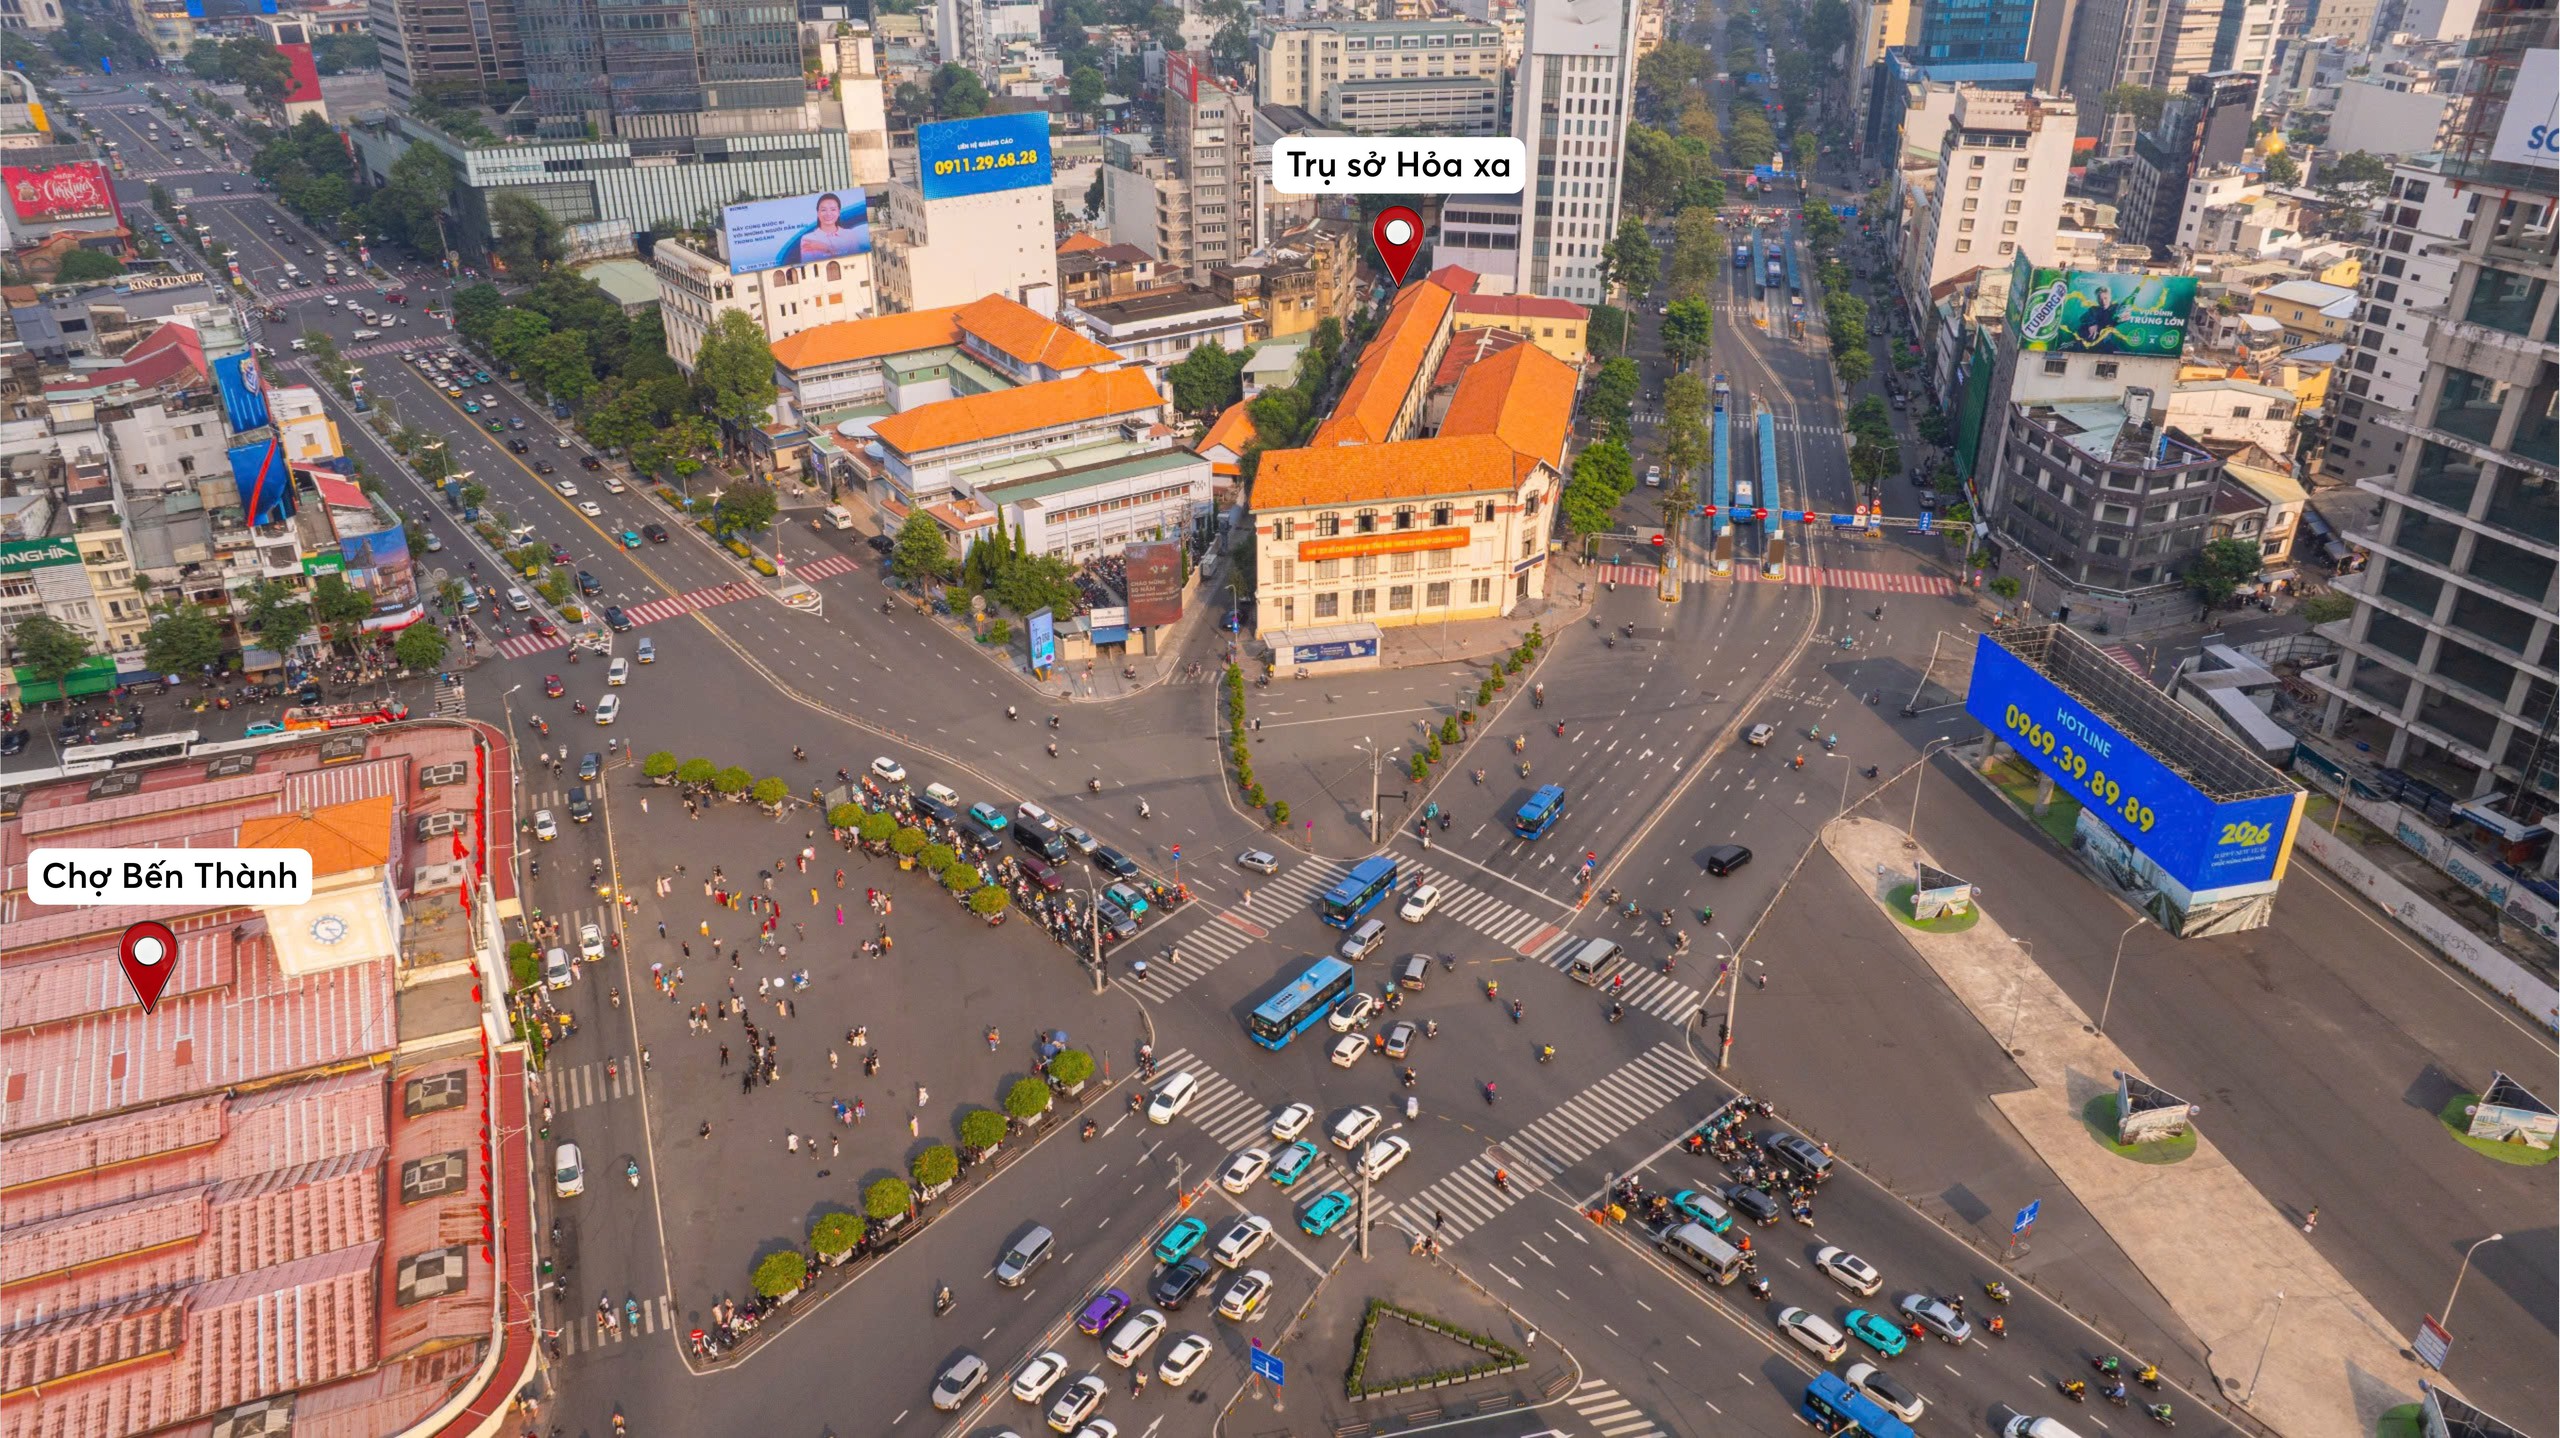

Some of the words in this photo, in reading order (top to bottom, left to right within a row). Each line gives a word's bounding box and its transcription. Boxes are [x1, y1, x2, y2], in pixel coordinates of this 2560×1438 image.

[957, 142, 969, 150] LIÊN
[978, 139, 999, 148] QUẢNG
[1000, 137, 1014, 145] CÁO
[934, 149, 1038, 176] 0911.29.68.28
[129, 279, 158, 291] KING
[160, 272, 204, 287] LUXURY
[2025, 293, 2061, 334] TUBORG
[2057, 707, 2112, 759] HOTLINE
[2005, 703, 2155, 833] 0969.39.89.89
[2217, 821, 2272, 847] 2026
